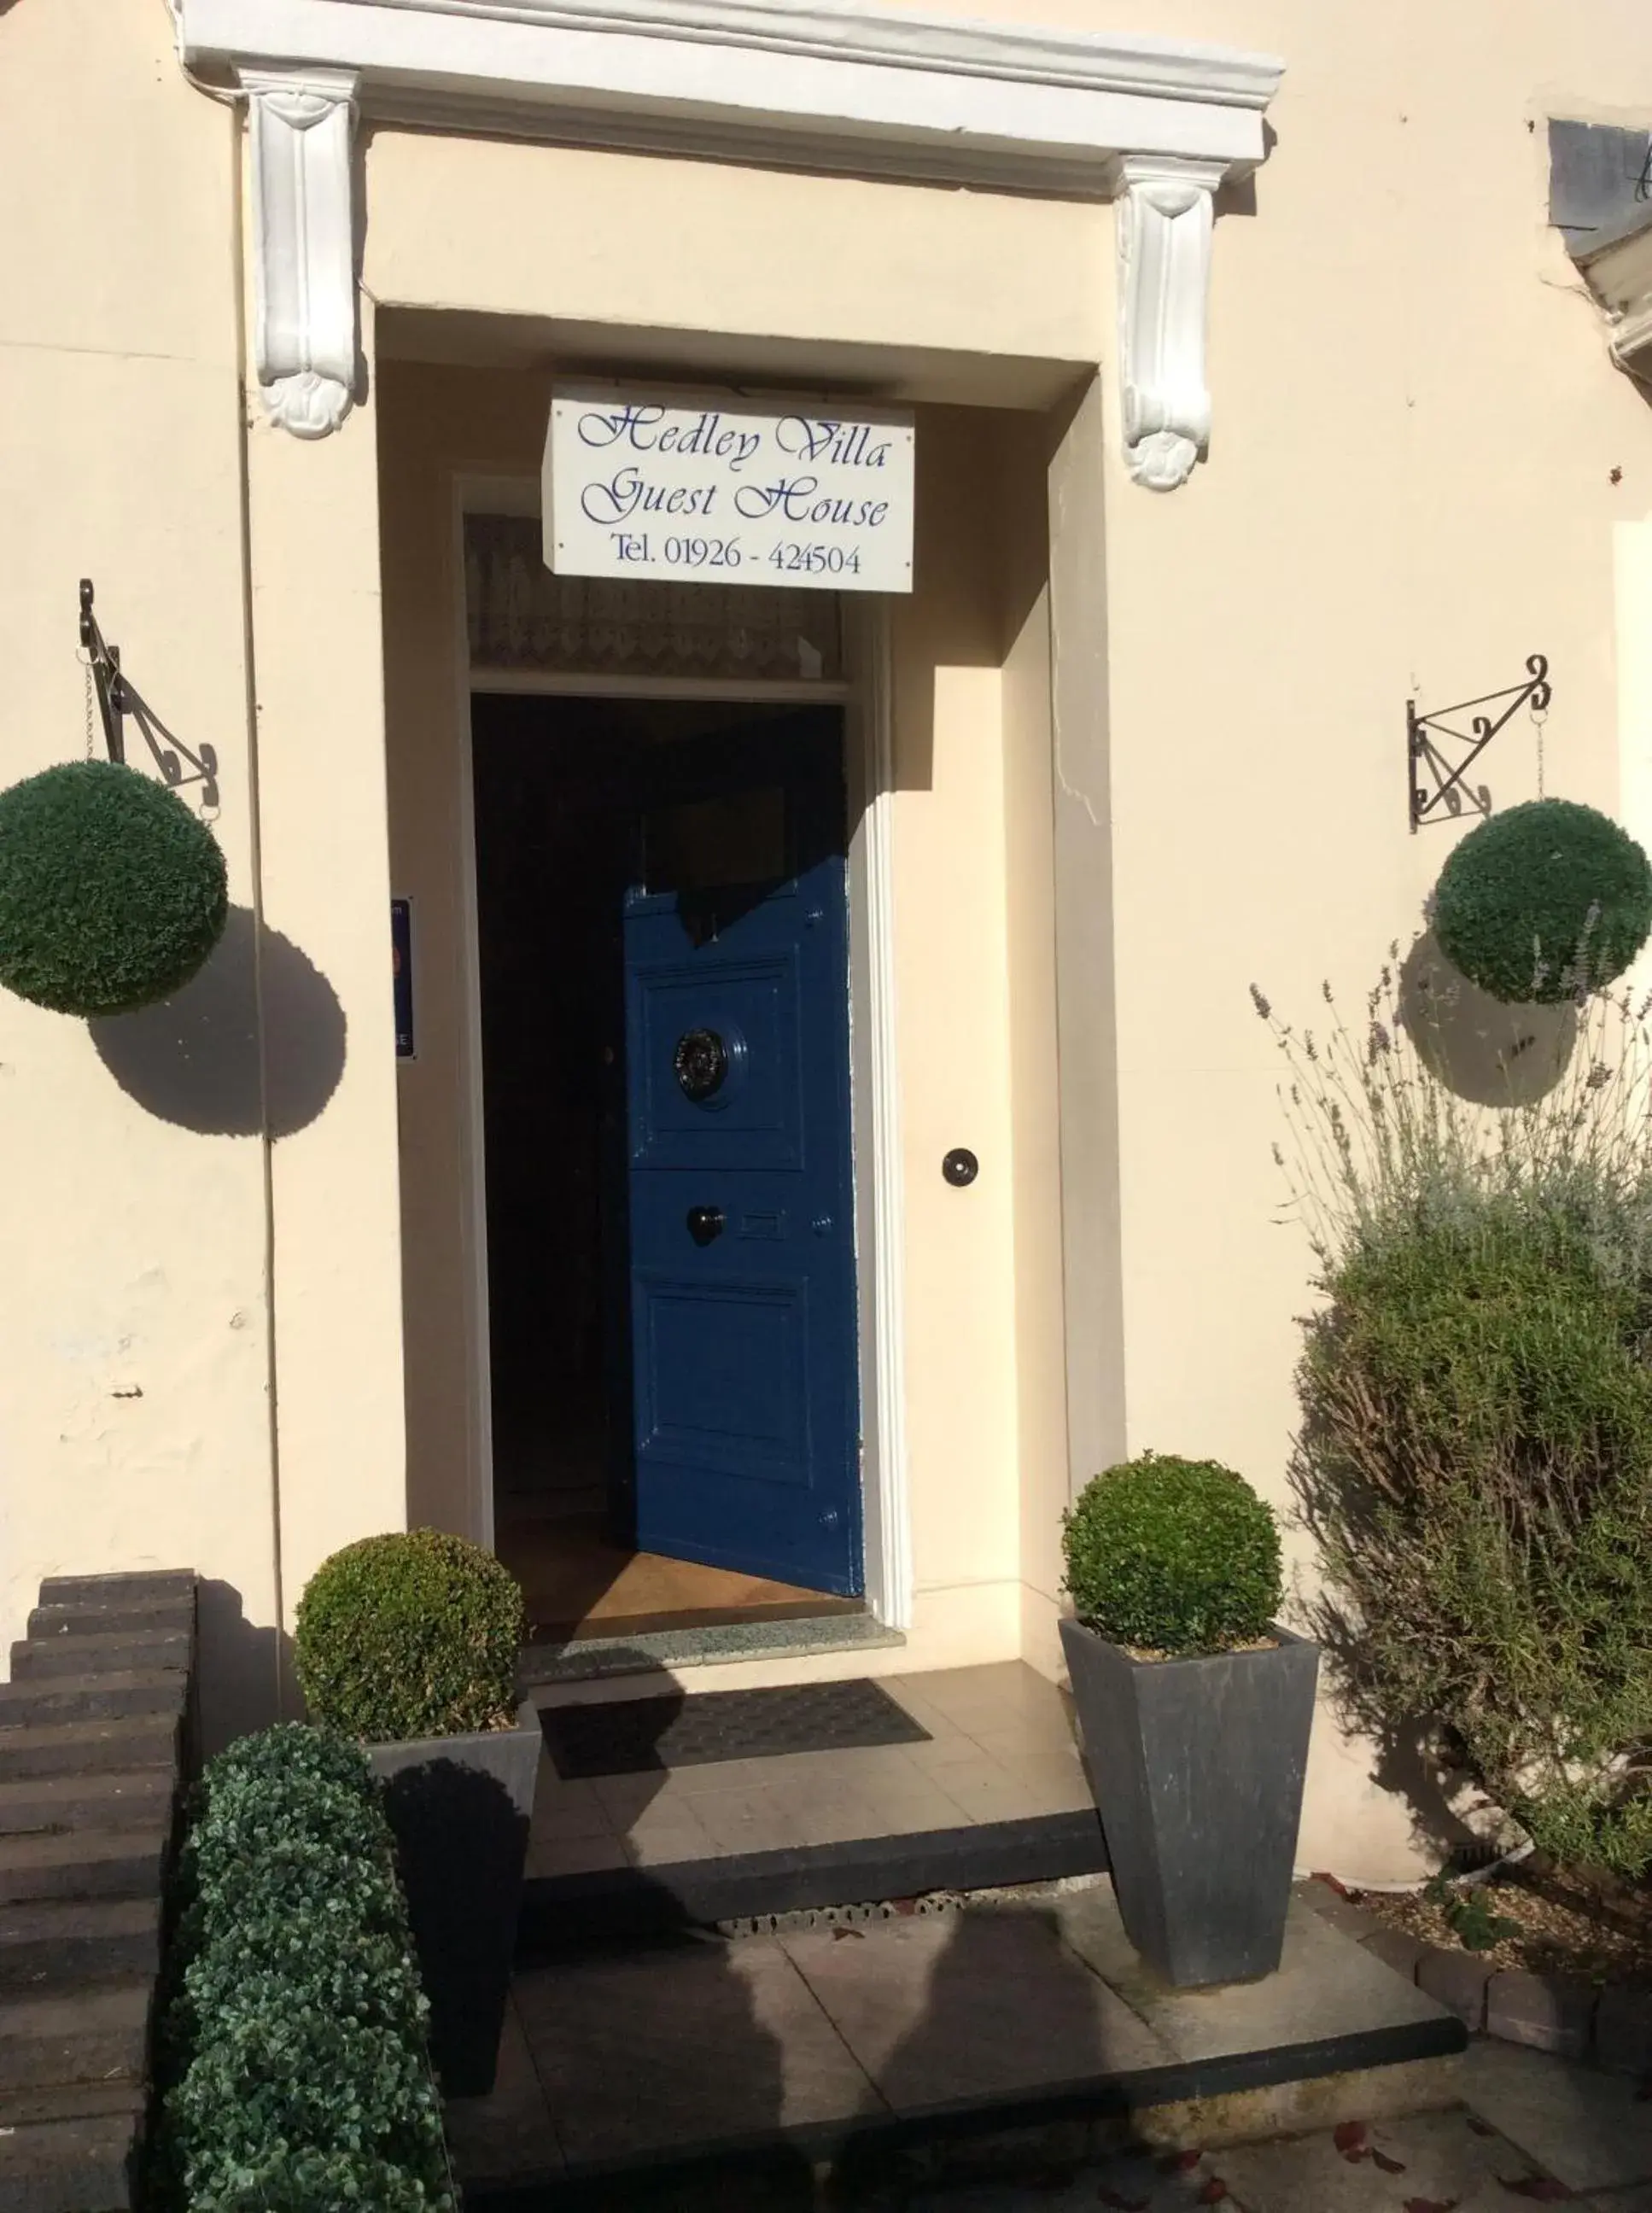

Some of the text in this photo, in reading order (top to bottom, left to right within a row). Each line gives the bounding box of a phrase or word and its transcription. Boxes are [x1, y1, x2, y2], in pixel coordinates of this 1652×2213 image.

[577, 404, 893, 472] Hedley Villa
[581, 466, 889, 527] Guest House
[610, 533, 656, 563] Tel.
[664, 536, 742, 567] 01926
[768, 540, 861, 575] 424504
